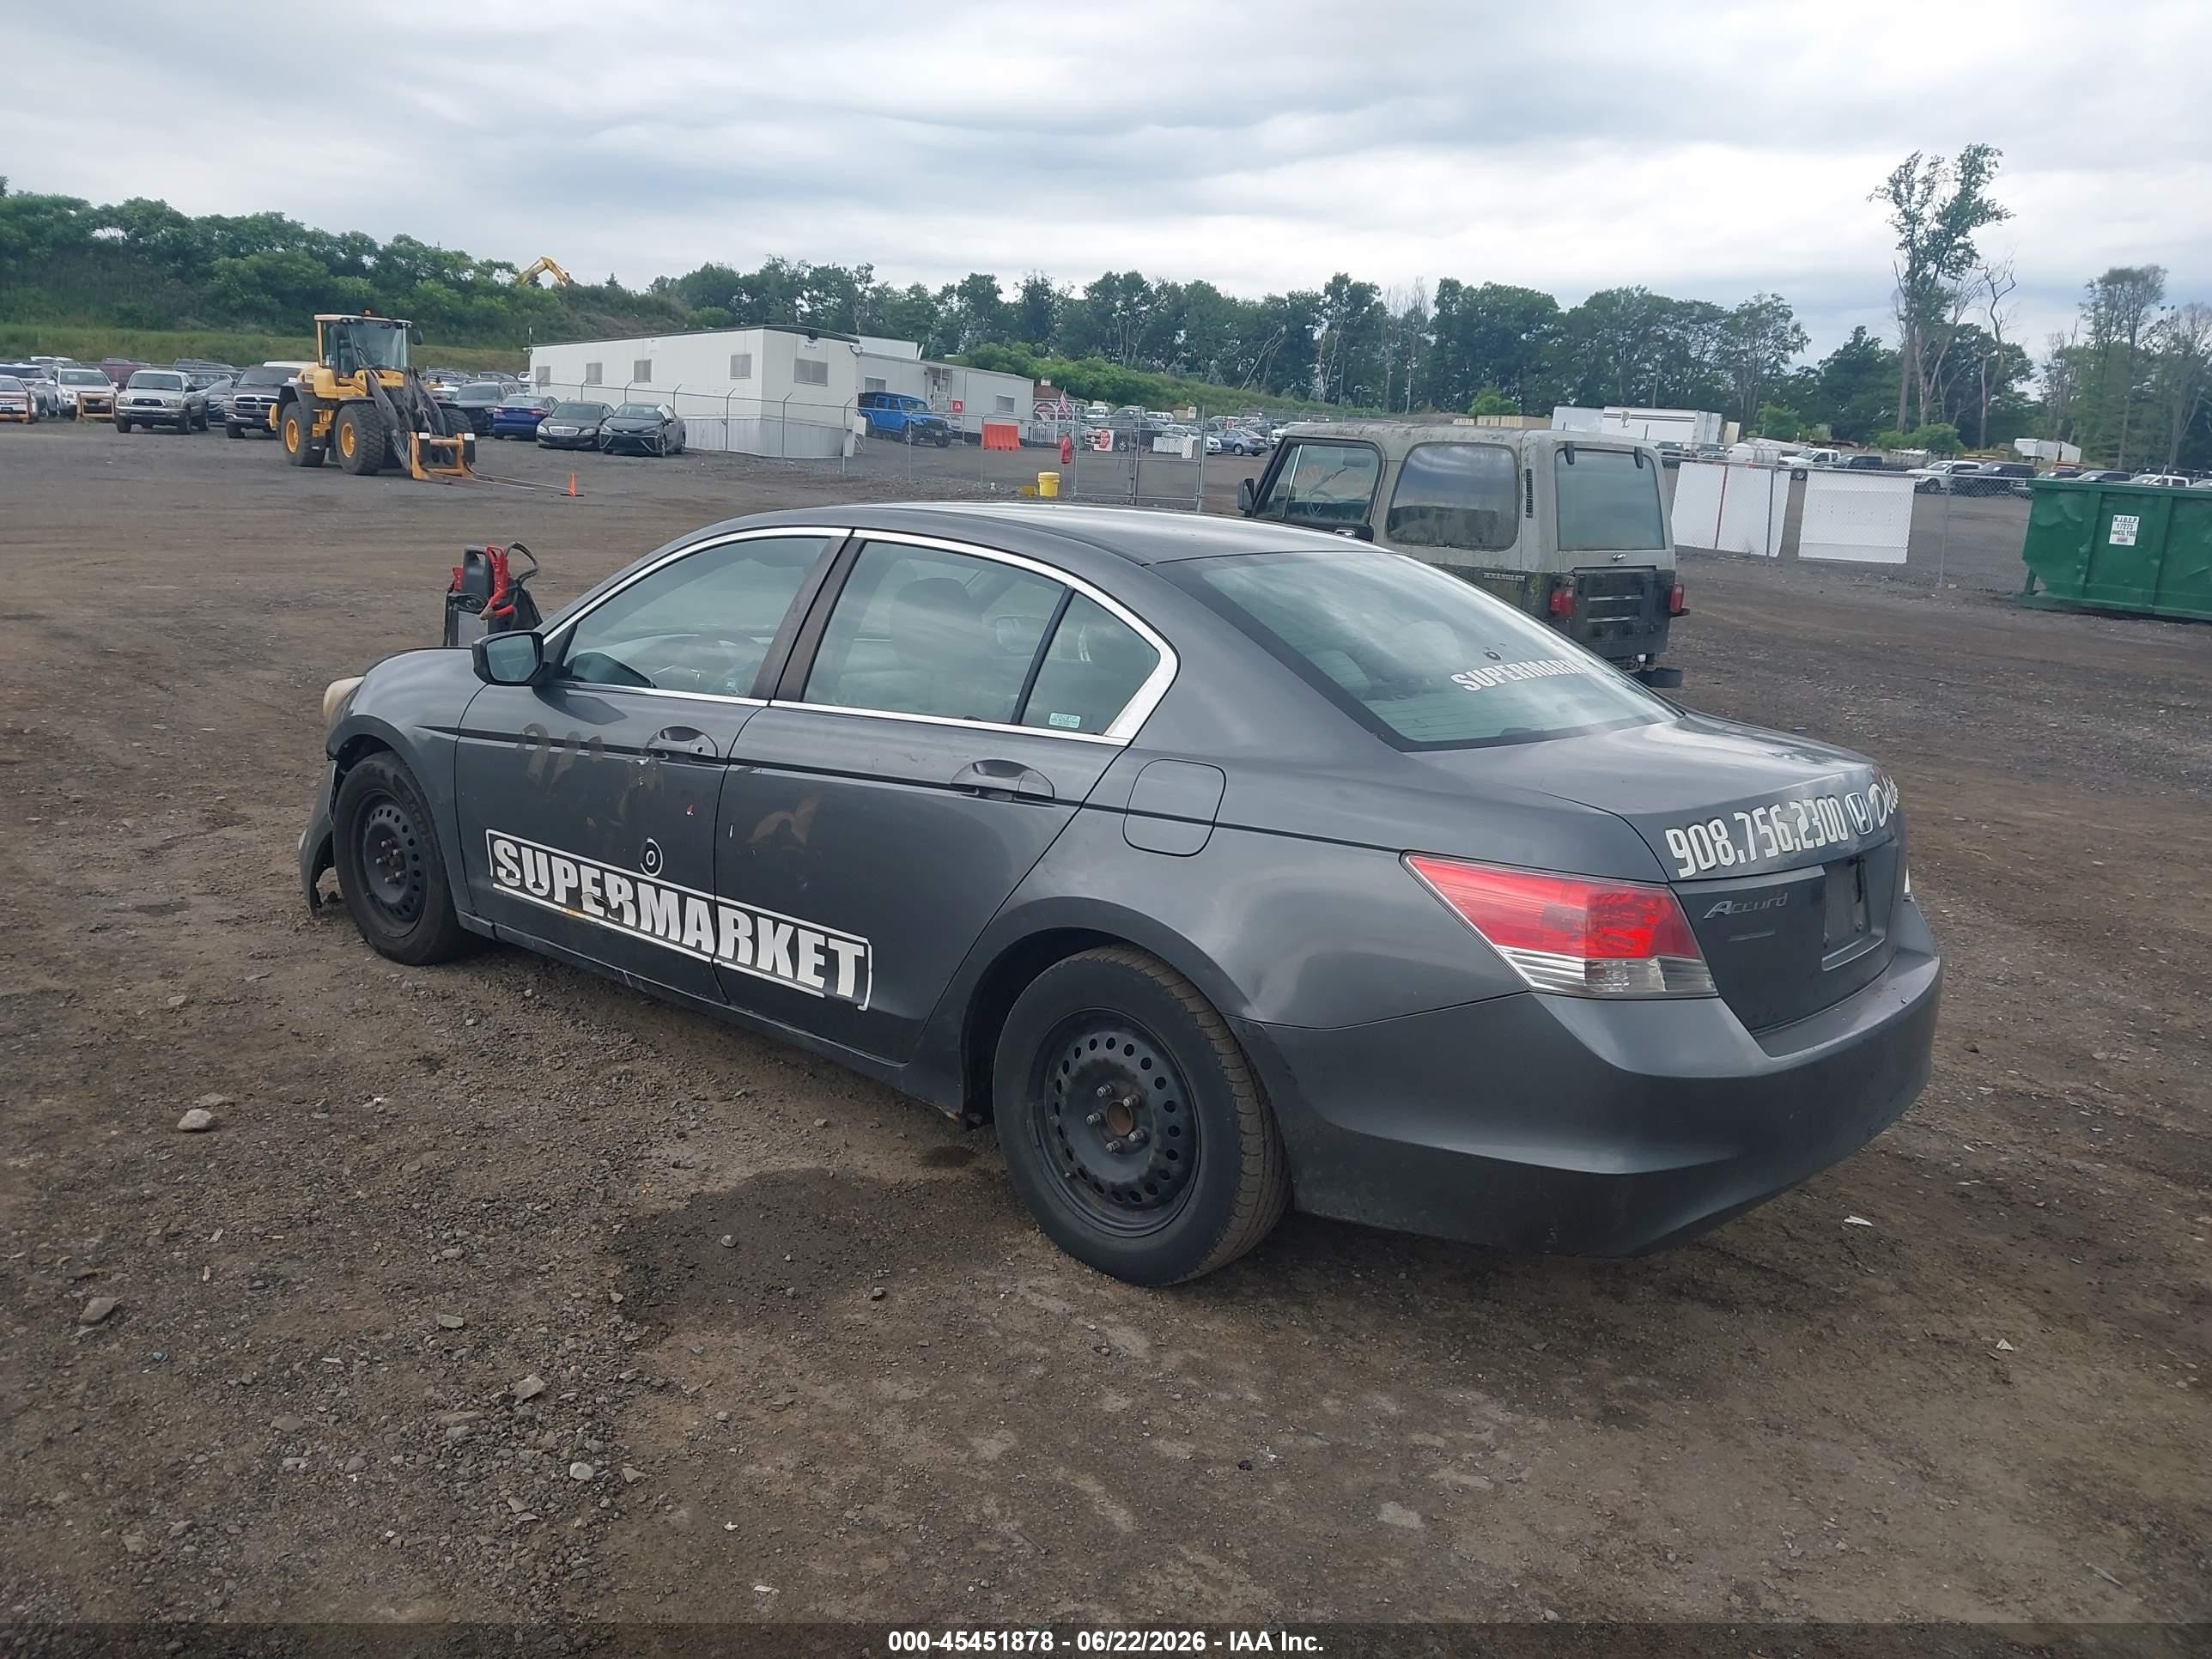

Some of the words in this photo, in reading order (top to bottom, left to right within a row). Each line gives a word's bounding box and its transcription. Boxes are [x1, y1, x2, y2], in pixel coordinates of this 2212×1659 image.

[1664, 795, 1849, 878] 908.756.2300
[492, 839, 866, 998] SUPERMARKET
[1703, 893, 1788, 919] Accord
